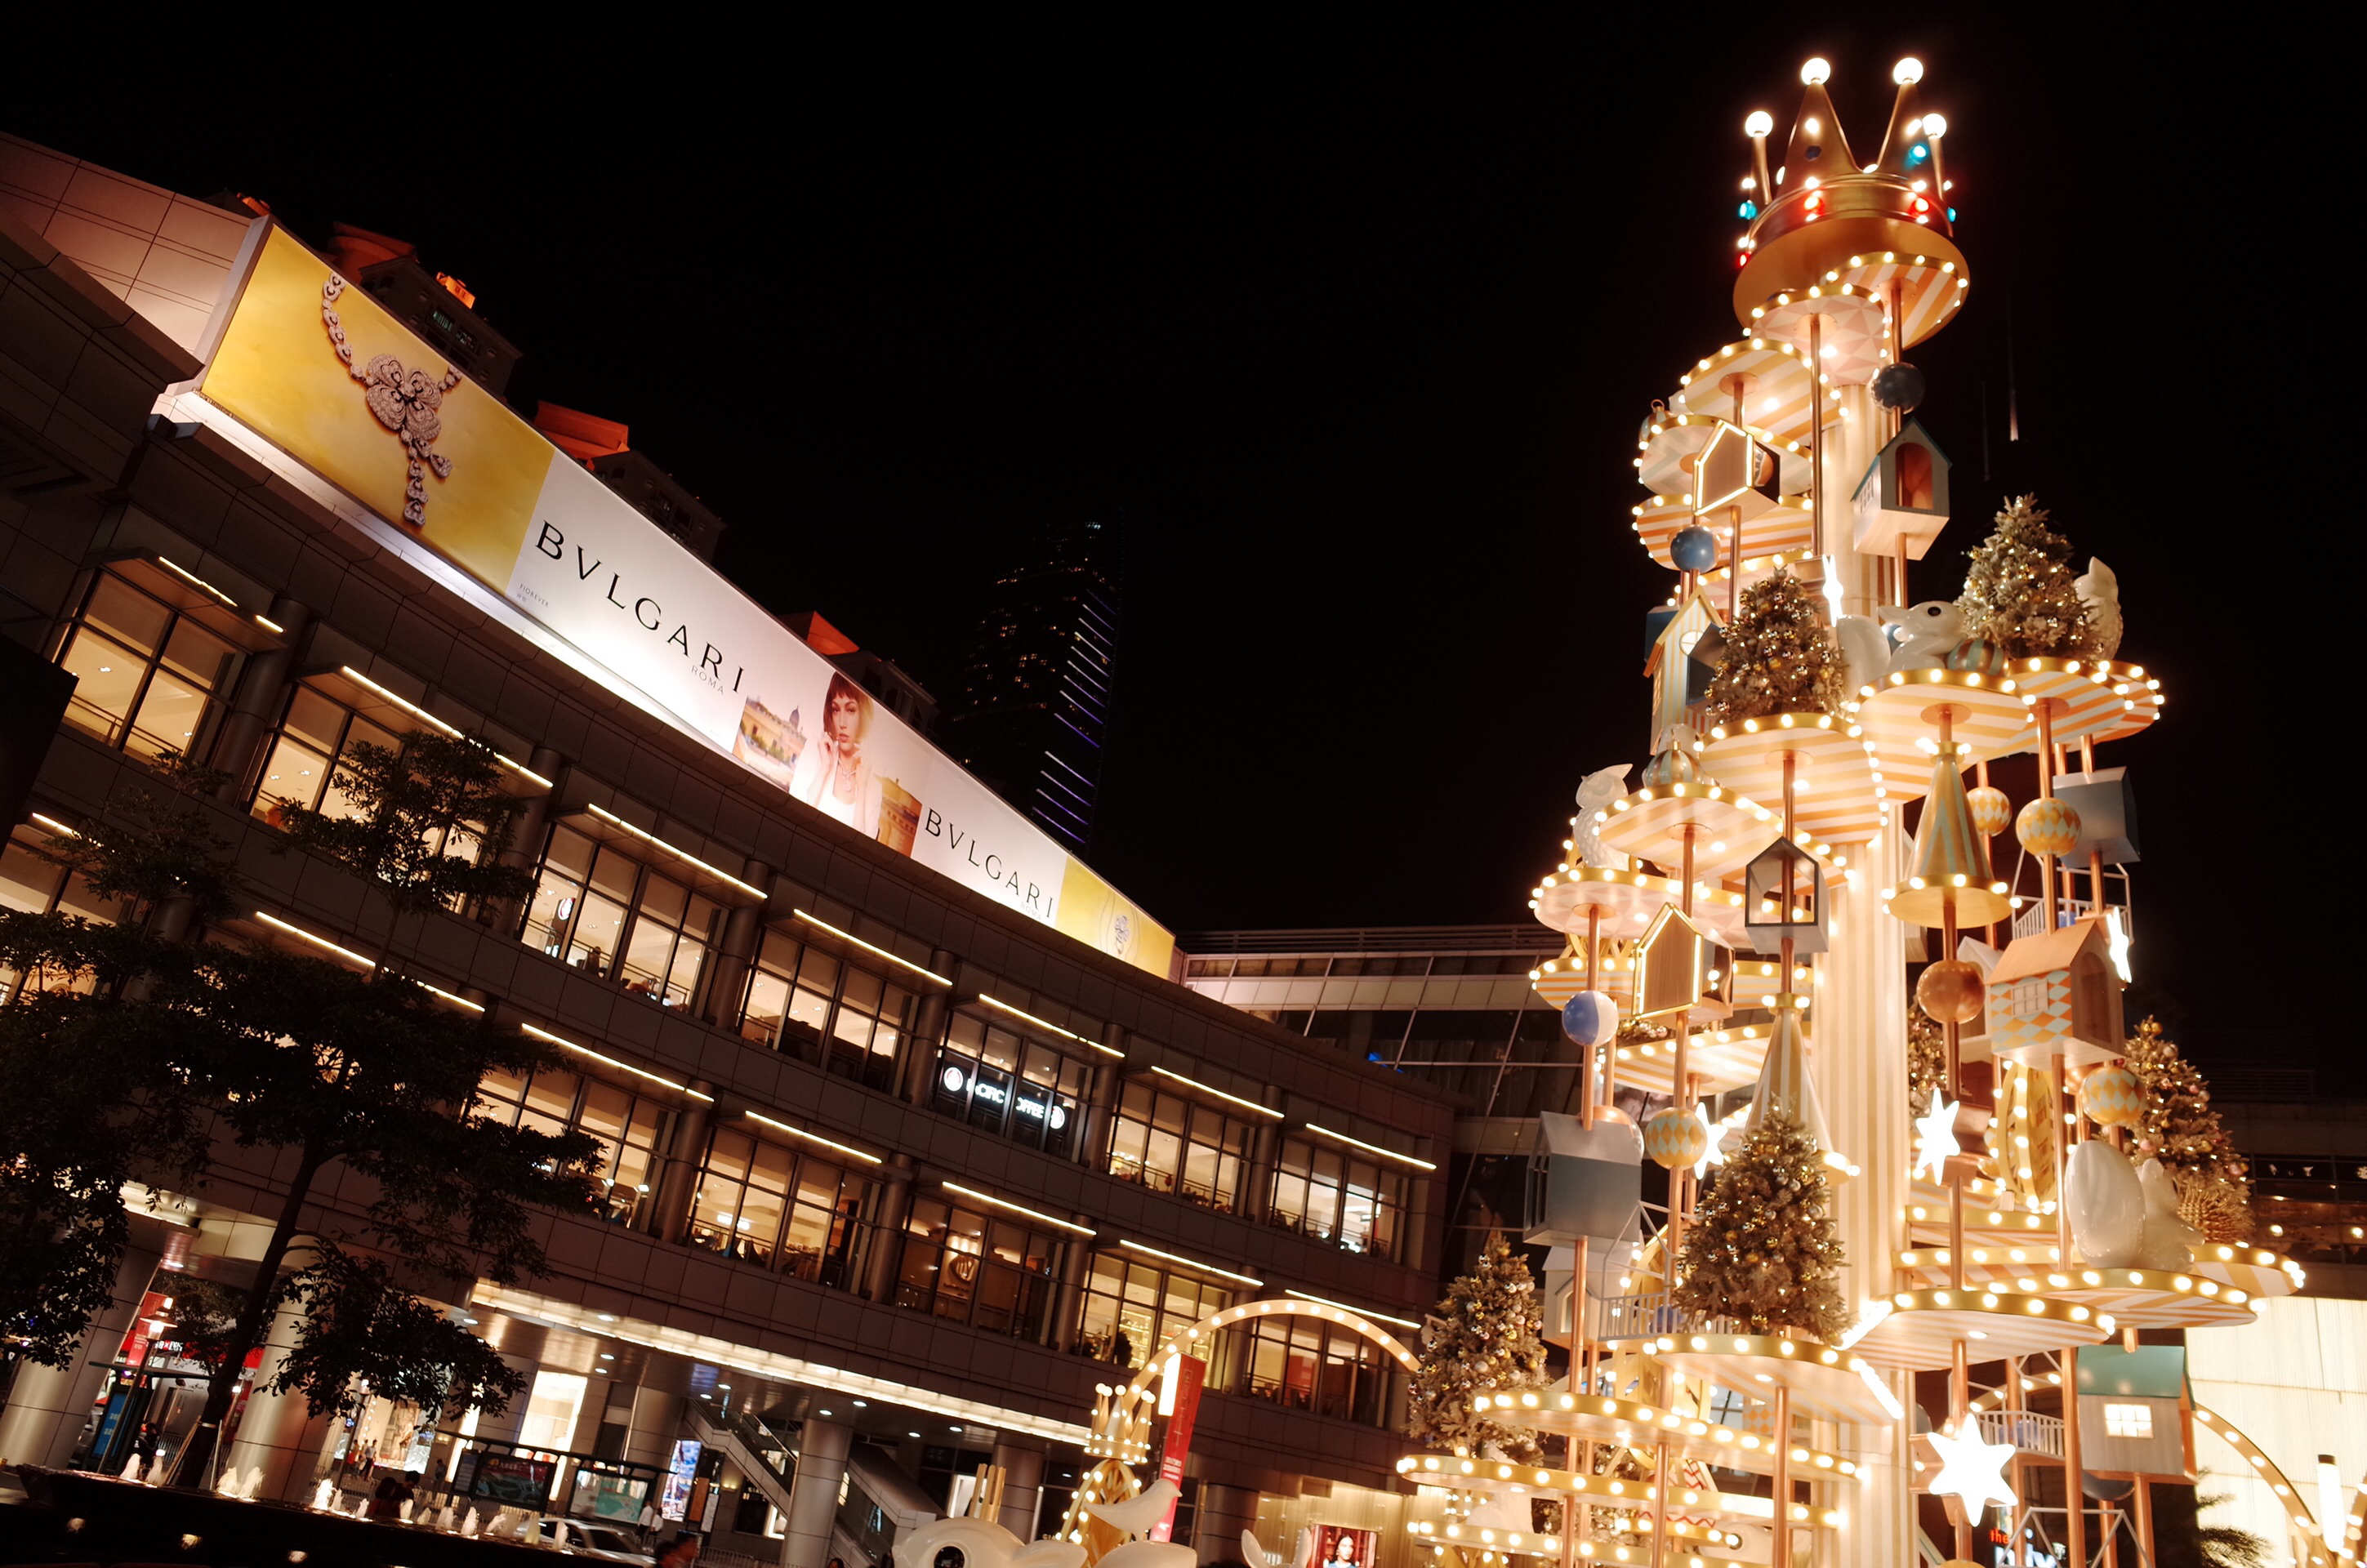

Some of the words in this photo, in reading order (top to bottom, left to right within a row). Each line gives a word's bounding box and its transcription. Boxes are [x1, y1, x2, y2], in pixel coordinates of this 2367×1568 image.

[519, 583, 549, 608] FIOREVER
[535, 520, 744, 693] BVLGARI
[691, 665, 724, 695] ROMA
[925, 808, 1054, 919] BVLGARI
[1990, 1526, 2010, 1545] the
